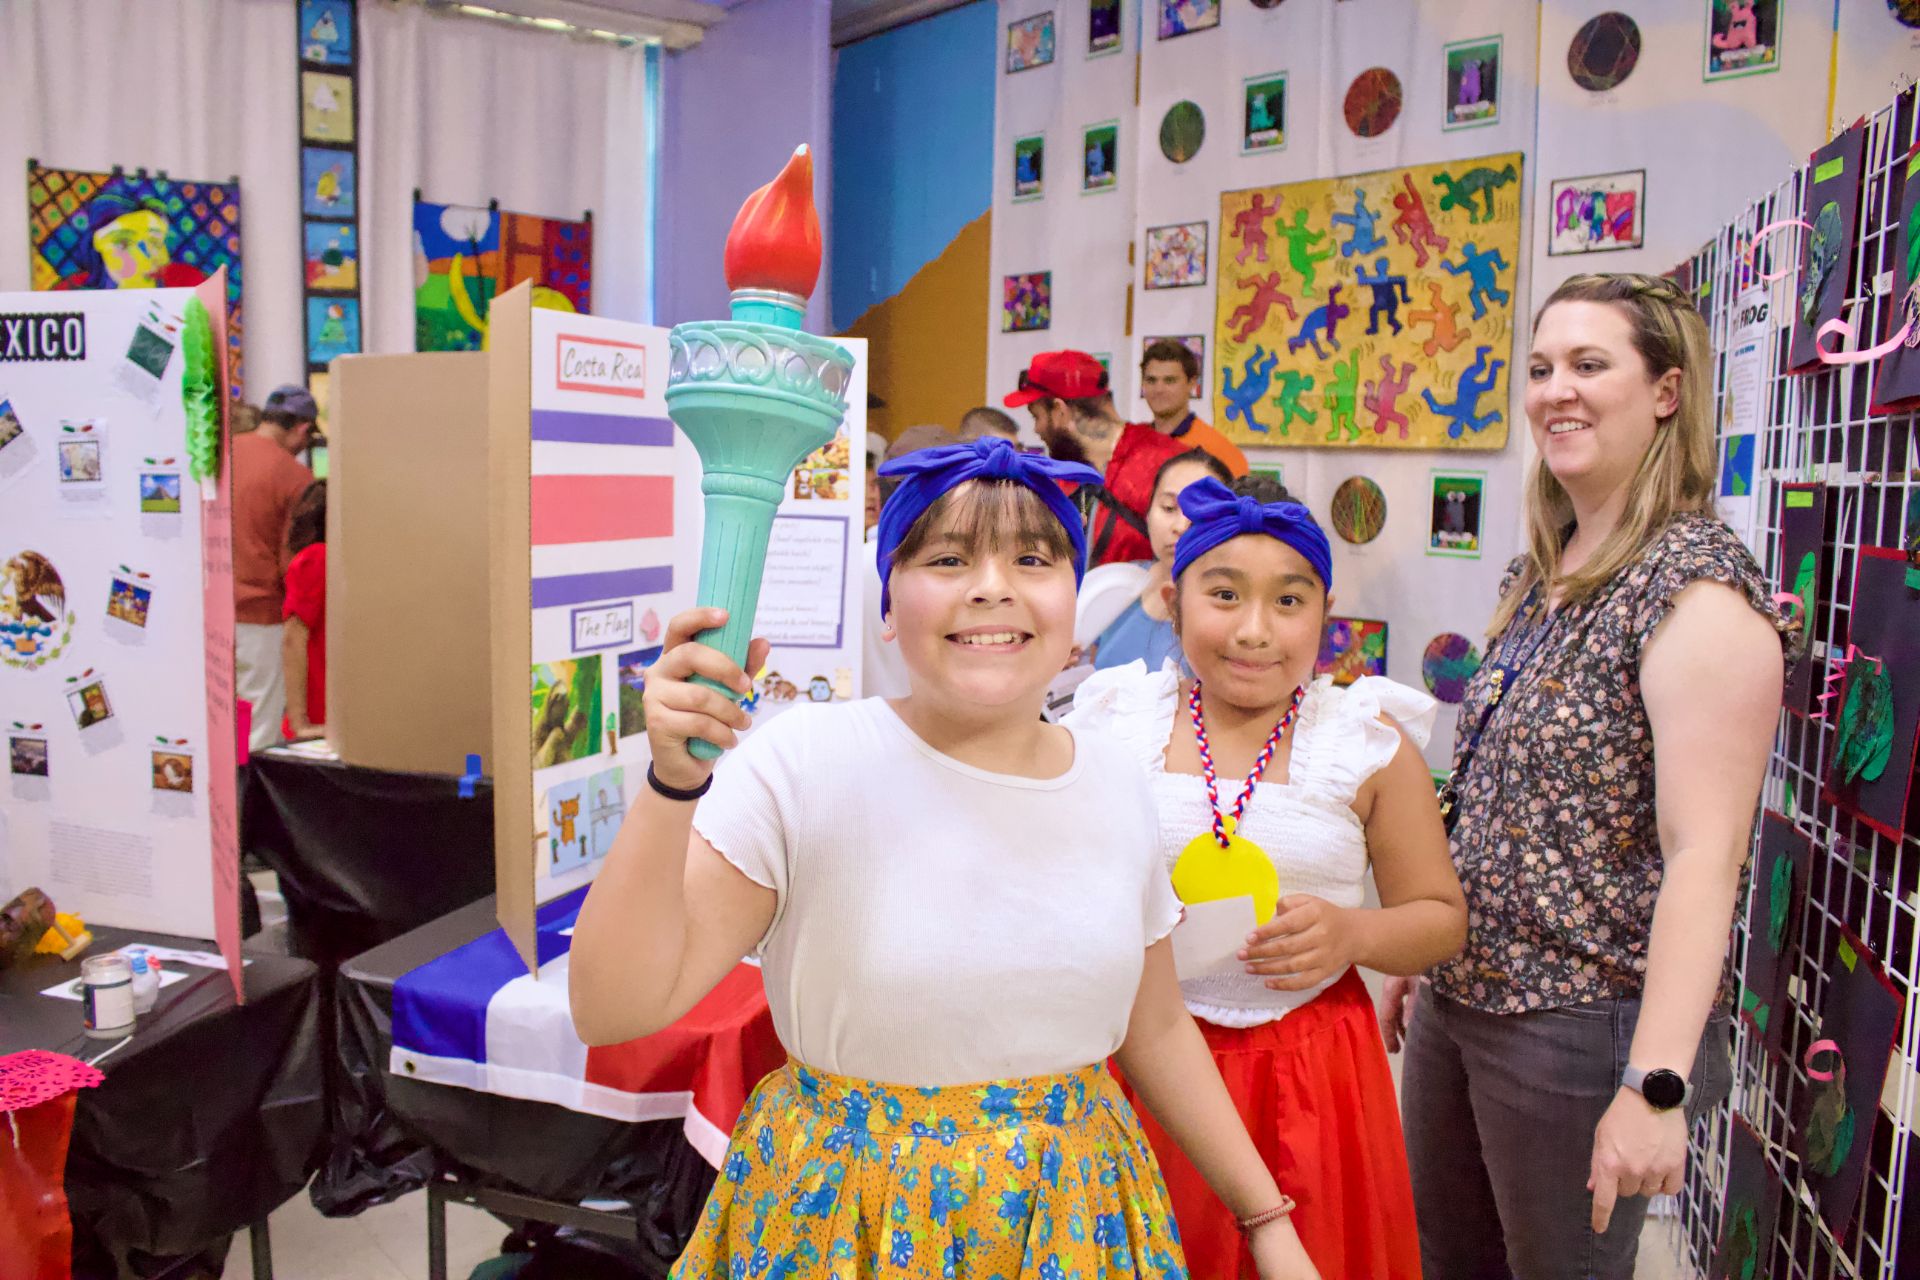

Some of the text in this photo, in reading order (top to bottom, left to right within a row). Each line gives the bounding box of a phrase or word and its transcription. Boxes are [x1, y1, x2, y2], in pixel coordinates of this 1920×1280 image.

[0, 318, 82, 357] XICO
[564, 347, 642, 381] Costa Rica
[579, 612, 629, 640] The Flag
